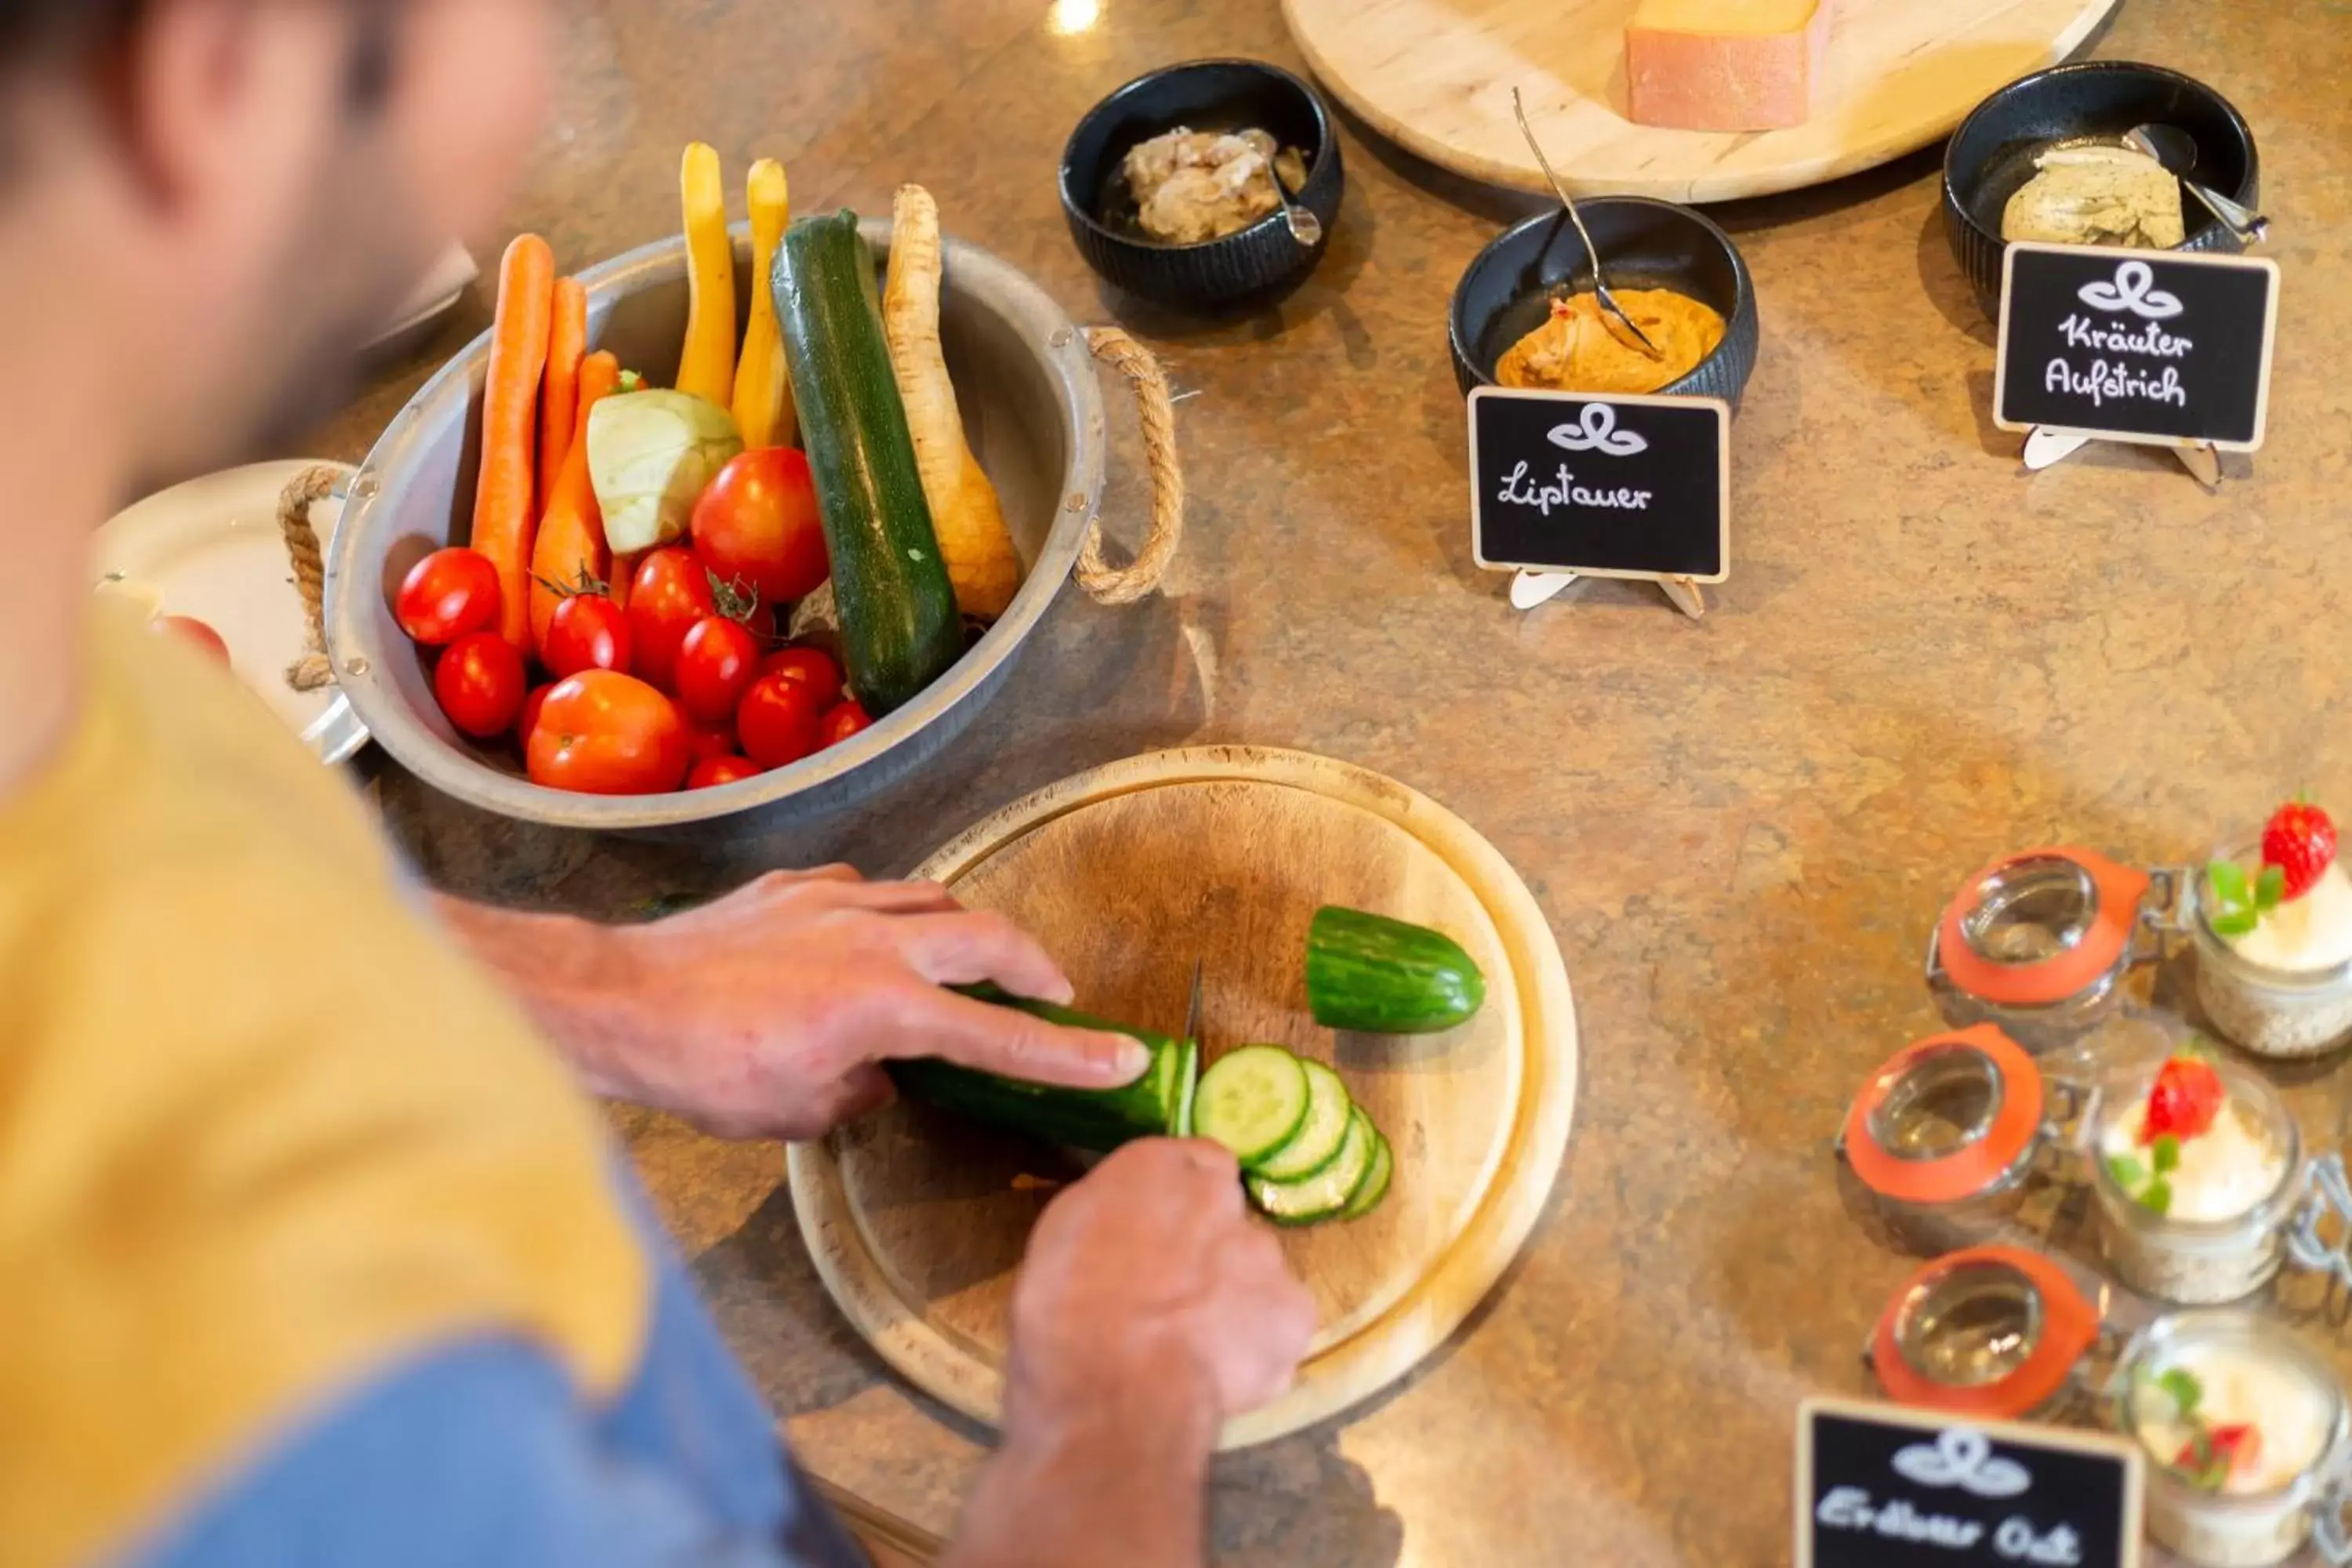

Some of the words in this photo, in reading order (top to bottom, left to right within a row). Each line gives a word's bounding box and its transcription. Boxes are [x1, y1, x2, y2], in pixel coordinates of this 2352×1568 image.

[2057, 313, 2193, 358] Kräuter
[2045, 358, 2186, 407] Aufstrich
[1497, 460, 1653, 516] Liptauer
